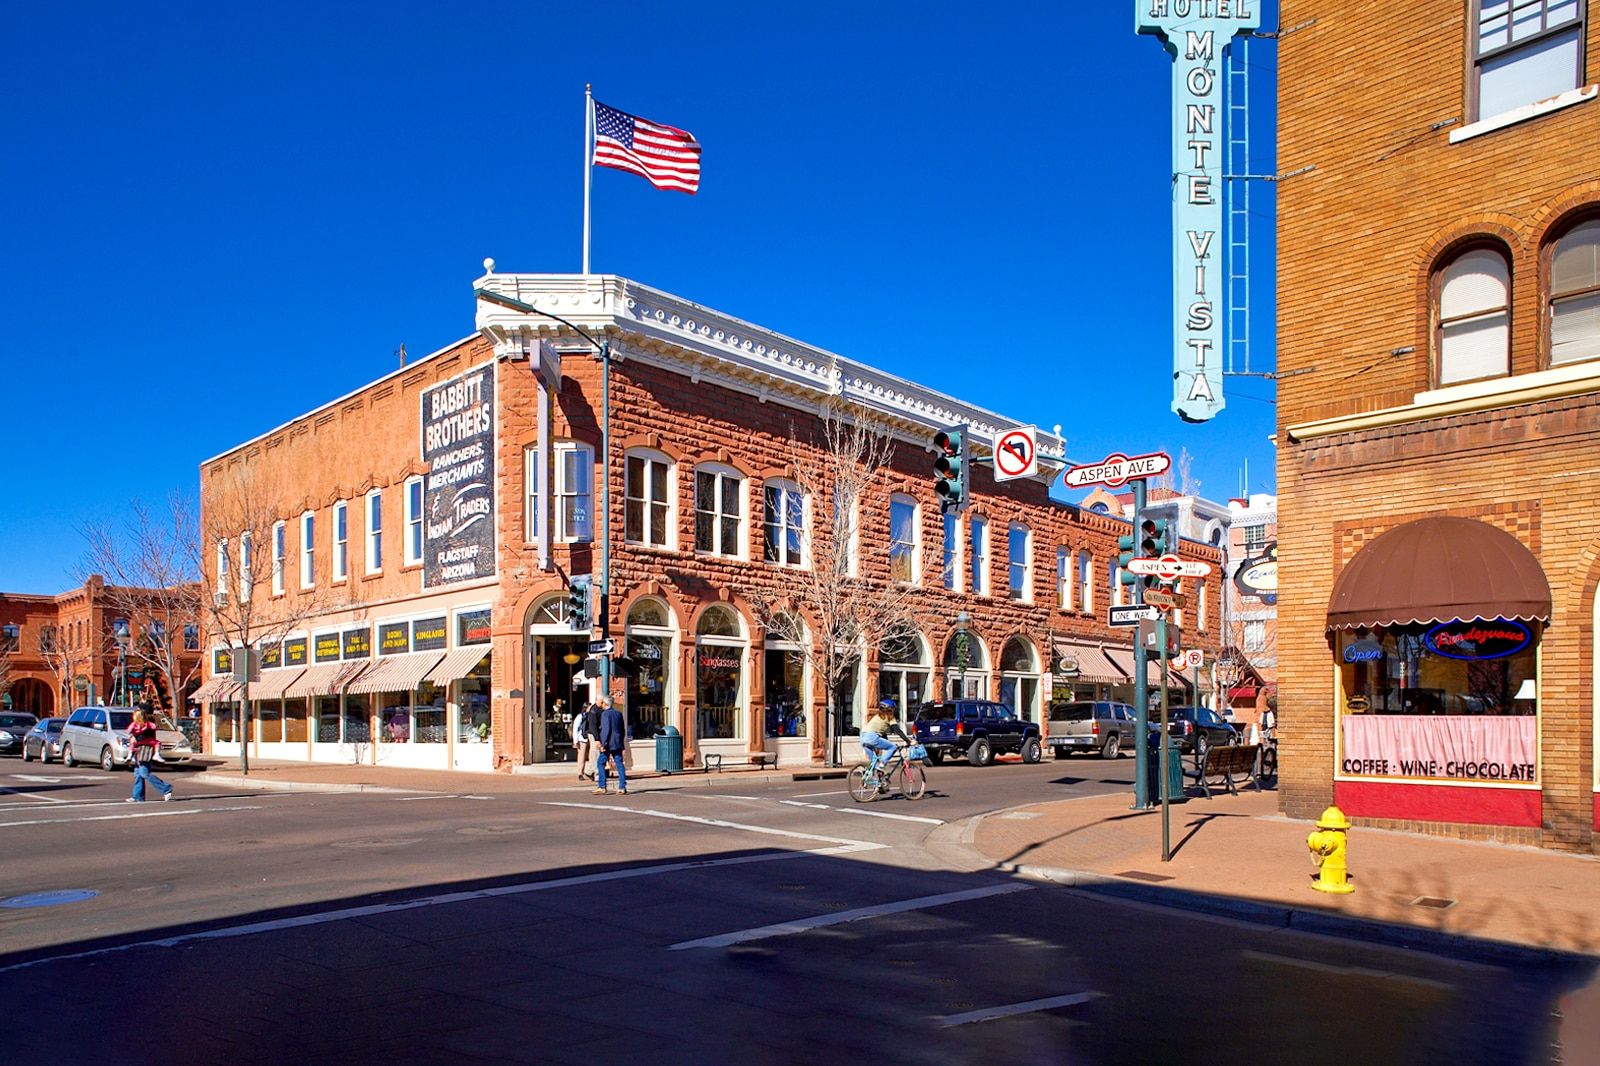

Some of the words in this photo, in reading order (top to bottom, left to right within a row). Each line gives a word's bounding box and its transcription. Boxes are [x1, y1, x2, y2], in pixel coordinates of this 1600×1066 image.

[1150, 0, 1251, 18] HOTEL
[1185, 31, 1216, 205] MONTE
[1186, 230, 1216, 402] VISTA
[431, 373, 484, 420] BABBITT
[426, 402, 490, 452] BROTHERS
[428, 458, 485, 490] MERCHANTS
[1079, 465, 1122, 483] ASPEN
[1128, 459, 1155, 475] AVE
[453, 497, 490, 523] TRADERS
[438, 545, 479, 564] FLAGSTAFF
[442, 562, 476, 579] ARIZONA
[1140, 563, 1168, 571] ASPEN
[1115, 609, 1131, 620] ONE
[1134, 608, 1150, 620] WAY
[416, 629, 446, 640] SUNGLASSES
[1435, 627, 1525, 648] Rendezvous
[700, 655, 739, 669] Sunglasses
[1344, 645, 1383, 663] Open
[1343, 759, 1388, 774] COFFEE
[1400, 760, 1436, 775] WINE
[1446, 761, 1535, 780] CHOCOLATE
